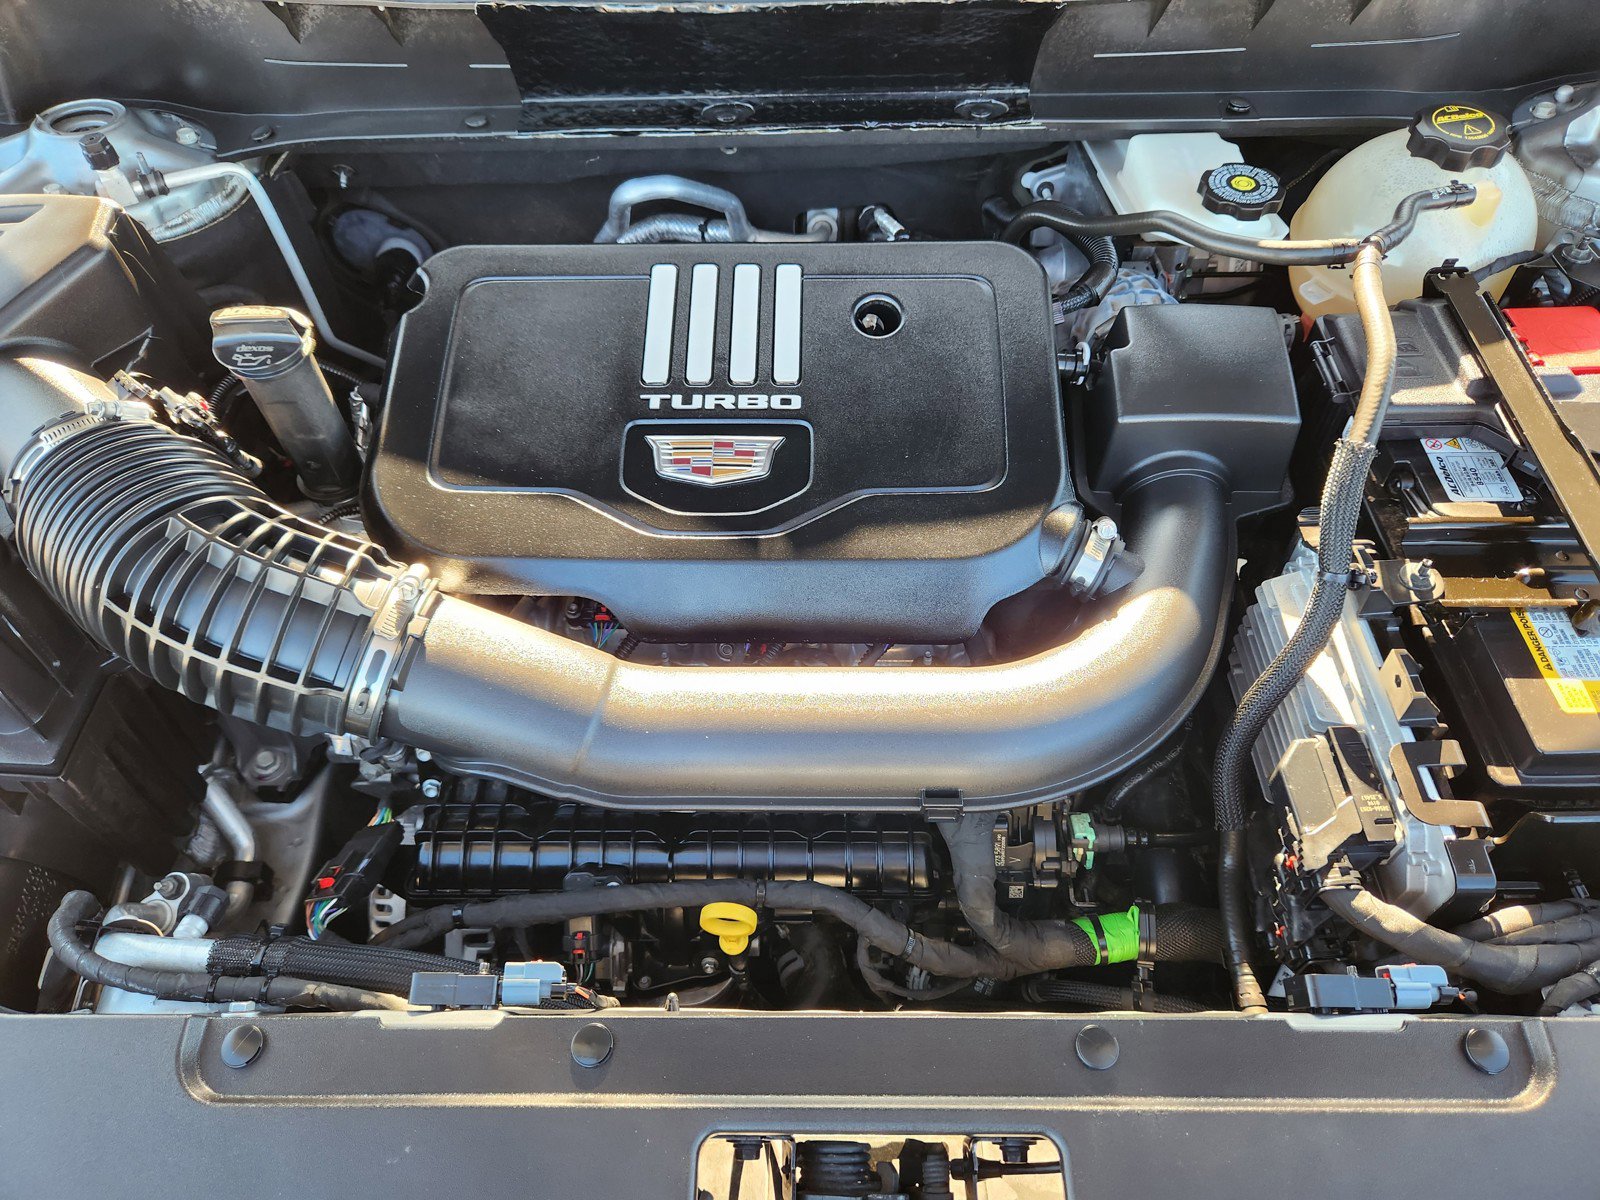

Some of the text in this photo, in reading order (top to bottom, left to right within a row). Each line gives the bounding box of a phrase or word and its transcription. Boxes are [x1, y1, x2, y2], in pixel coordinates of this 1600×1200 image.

[235, 344, 275, 353] dexos
[639, 394, 802, 410] TURBO
[1436, 456, 1462, 497] ACDelco
[1469, 467, 1485, 486] 8540
